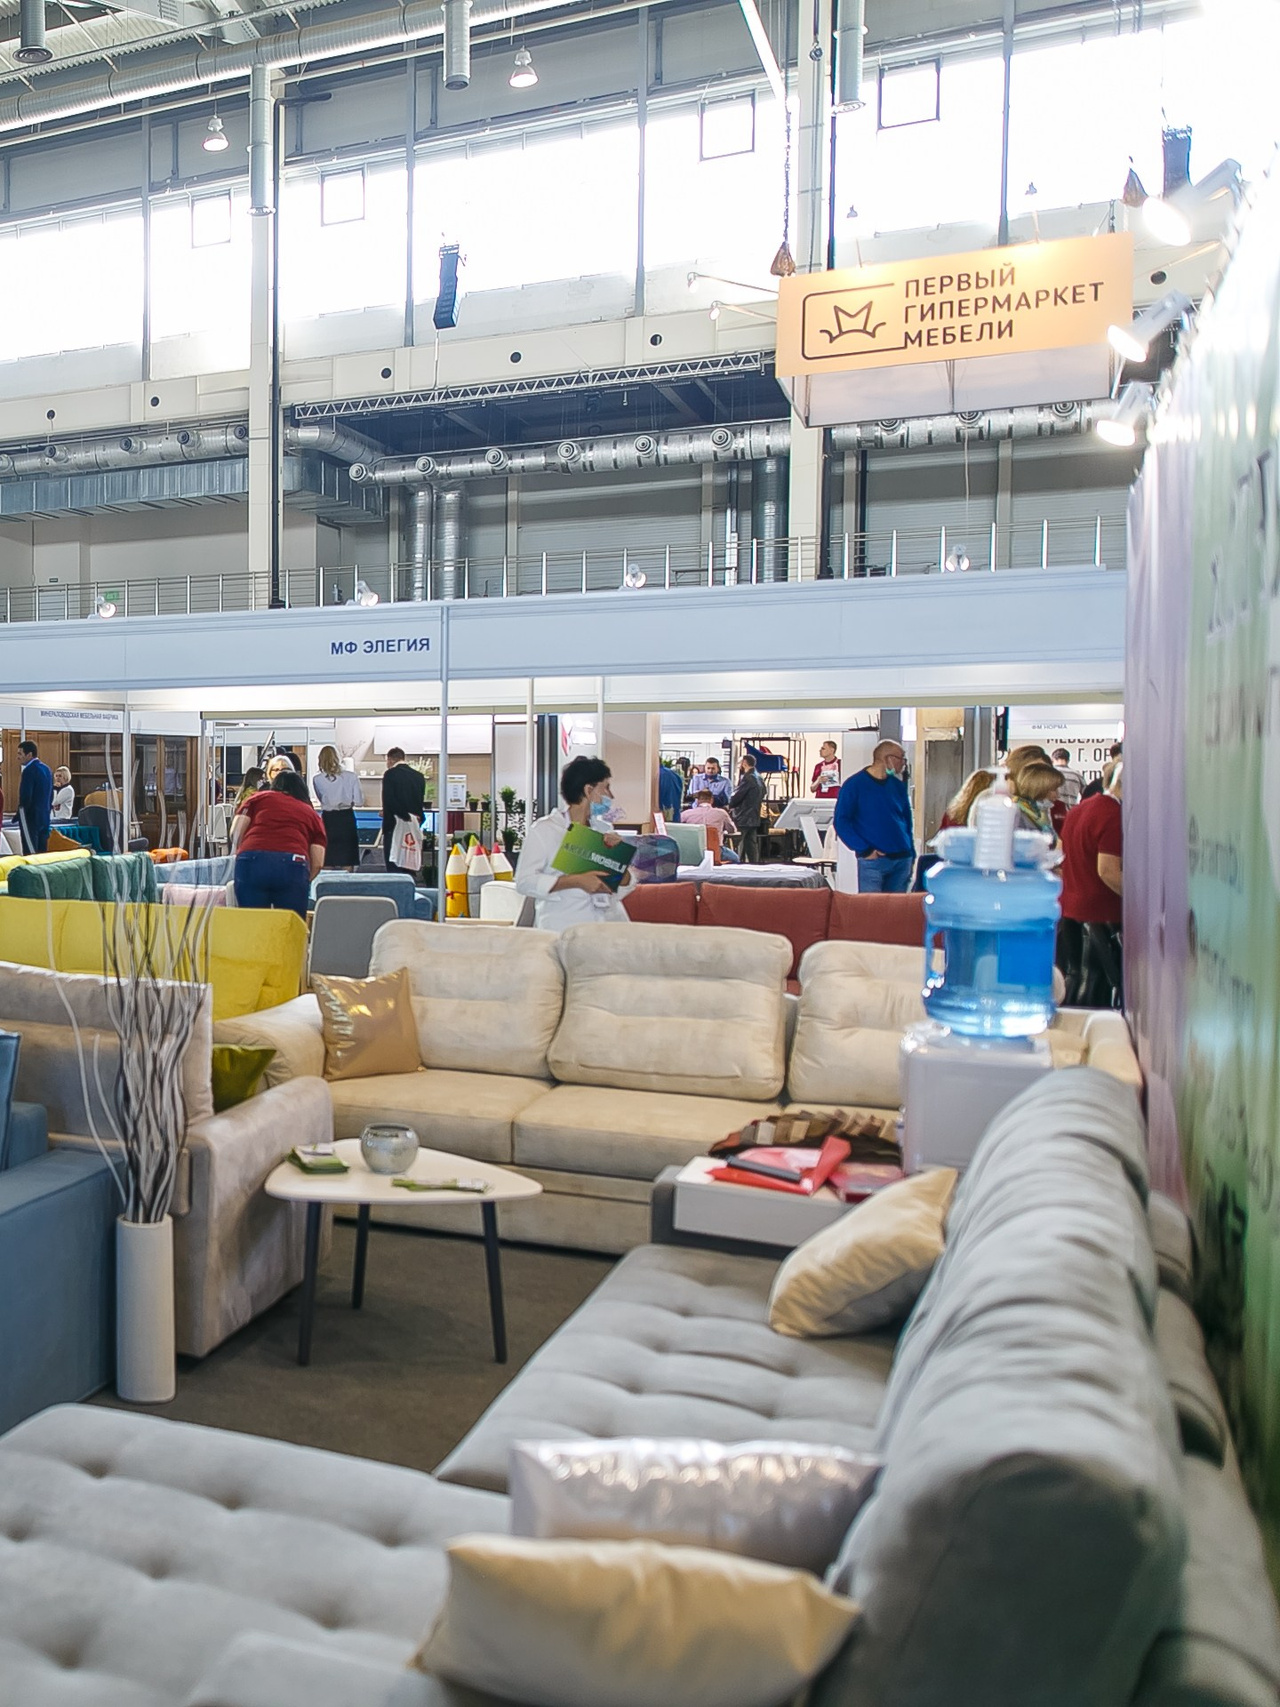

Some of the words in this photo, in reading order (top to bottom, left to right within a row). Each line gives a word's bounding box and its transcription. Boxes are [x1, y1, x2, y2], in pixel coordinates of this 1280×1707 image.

[905, 262, 1015, 298] ПЕРВЫЙ
[904, 282, 1104, 324] ГИПЕРМАРКЕТ
[904, 319, 1014, 349] МЕБЕЛИ
[331, 641, 358, 655] МФ
[363, 638, 430, 653] ЭЛЕГИЯ
